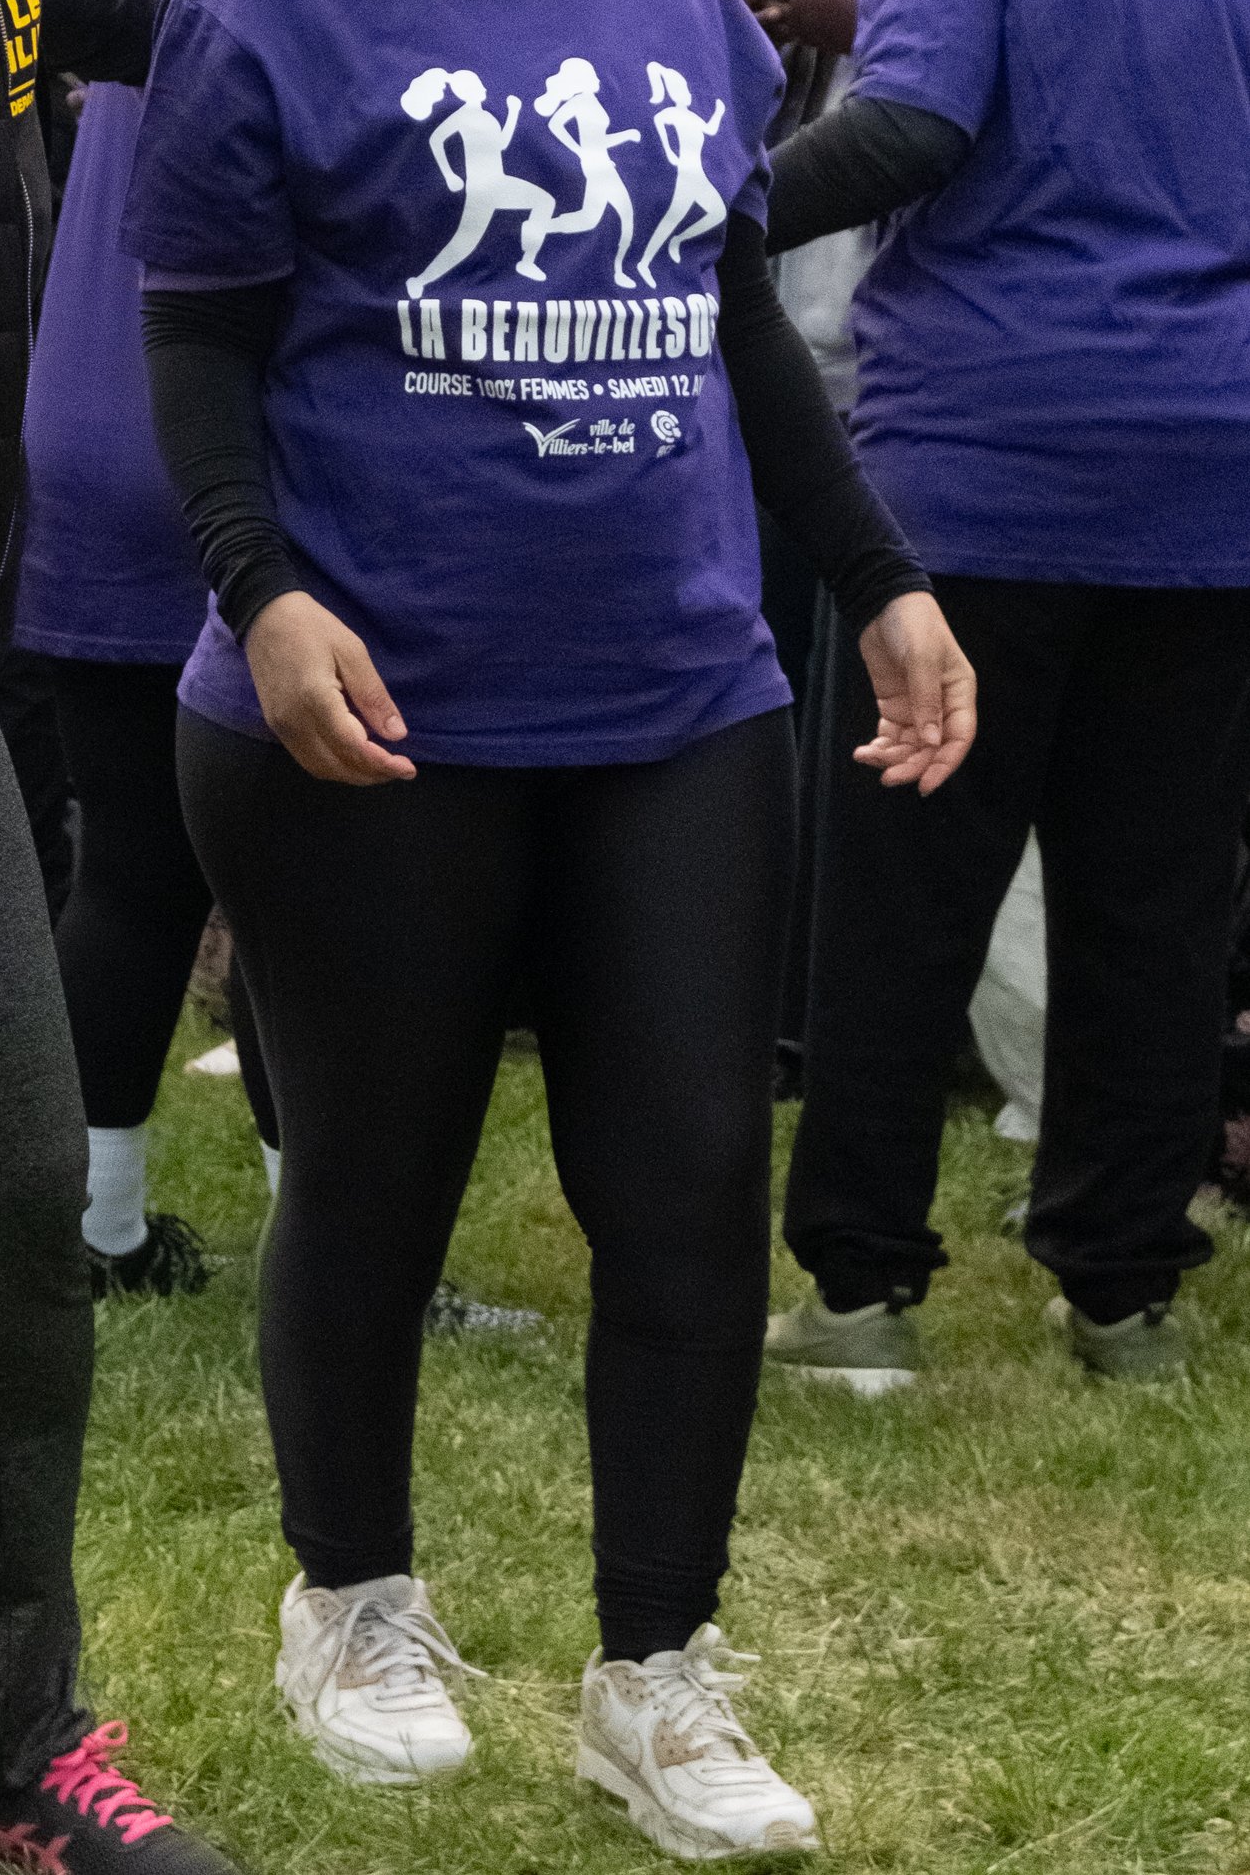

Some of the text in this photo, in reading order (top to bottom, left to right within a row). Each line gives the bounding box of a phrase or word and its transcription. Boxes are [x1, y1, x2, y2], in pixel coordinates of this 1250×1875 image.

[397, 299, 446, 359] LA
[404, 371, 472, 395] COURSE
[475, 377, 516, 401] 100%
[519, 377, 590, 401] FEMMES
[607, 375, 670, 399] SAMEDI
[671, 374, 690, 397] 12
[589, 418, 635, 436] ville de
